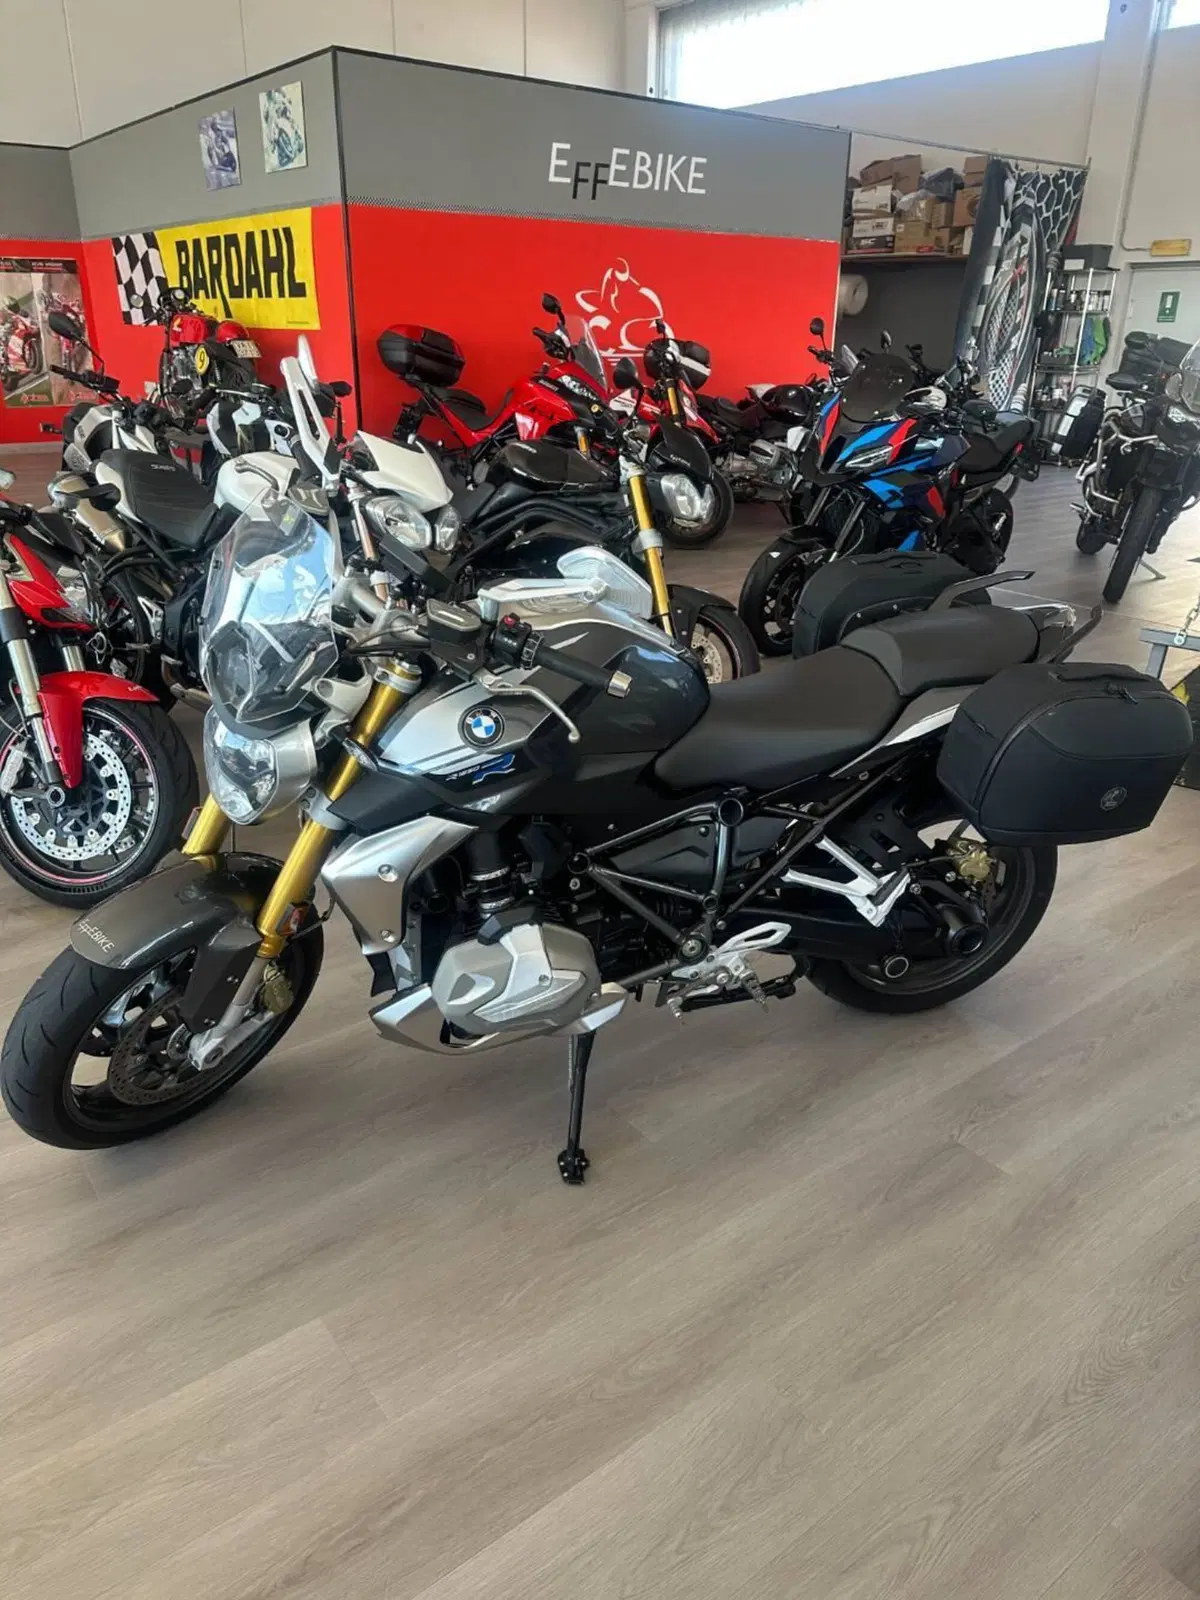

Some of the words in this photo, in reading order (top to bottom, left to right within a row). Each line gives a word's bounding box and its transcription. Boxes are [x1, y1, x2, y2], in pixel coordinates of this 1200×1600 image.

[548, 142, 707, 200] EFFEBIKE
[175, 226, 307, 319] BARDAHL
[199, 350, 206, 370] 9
